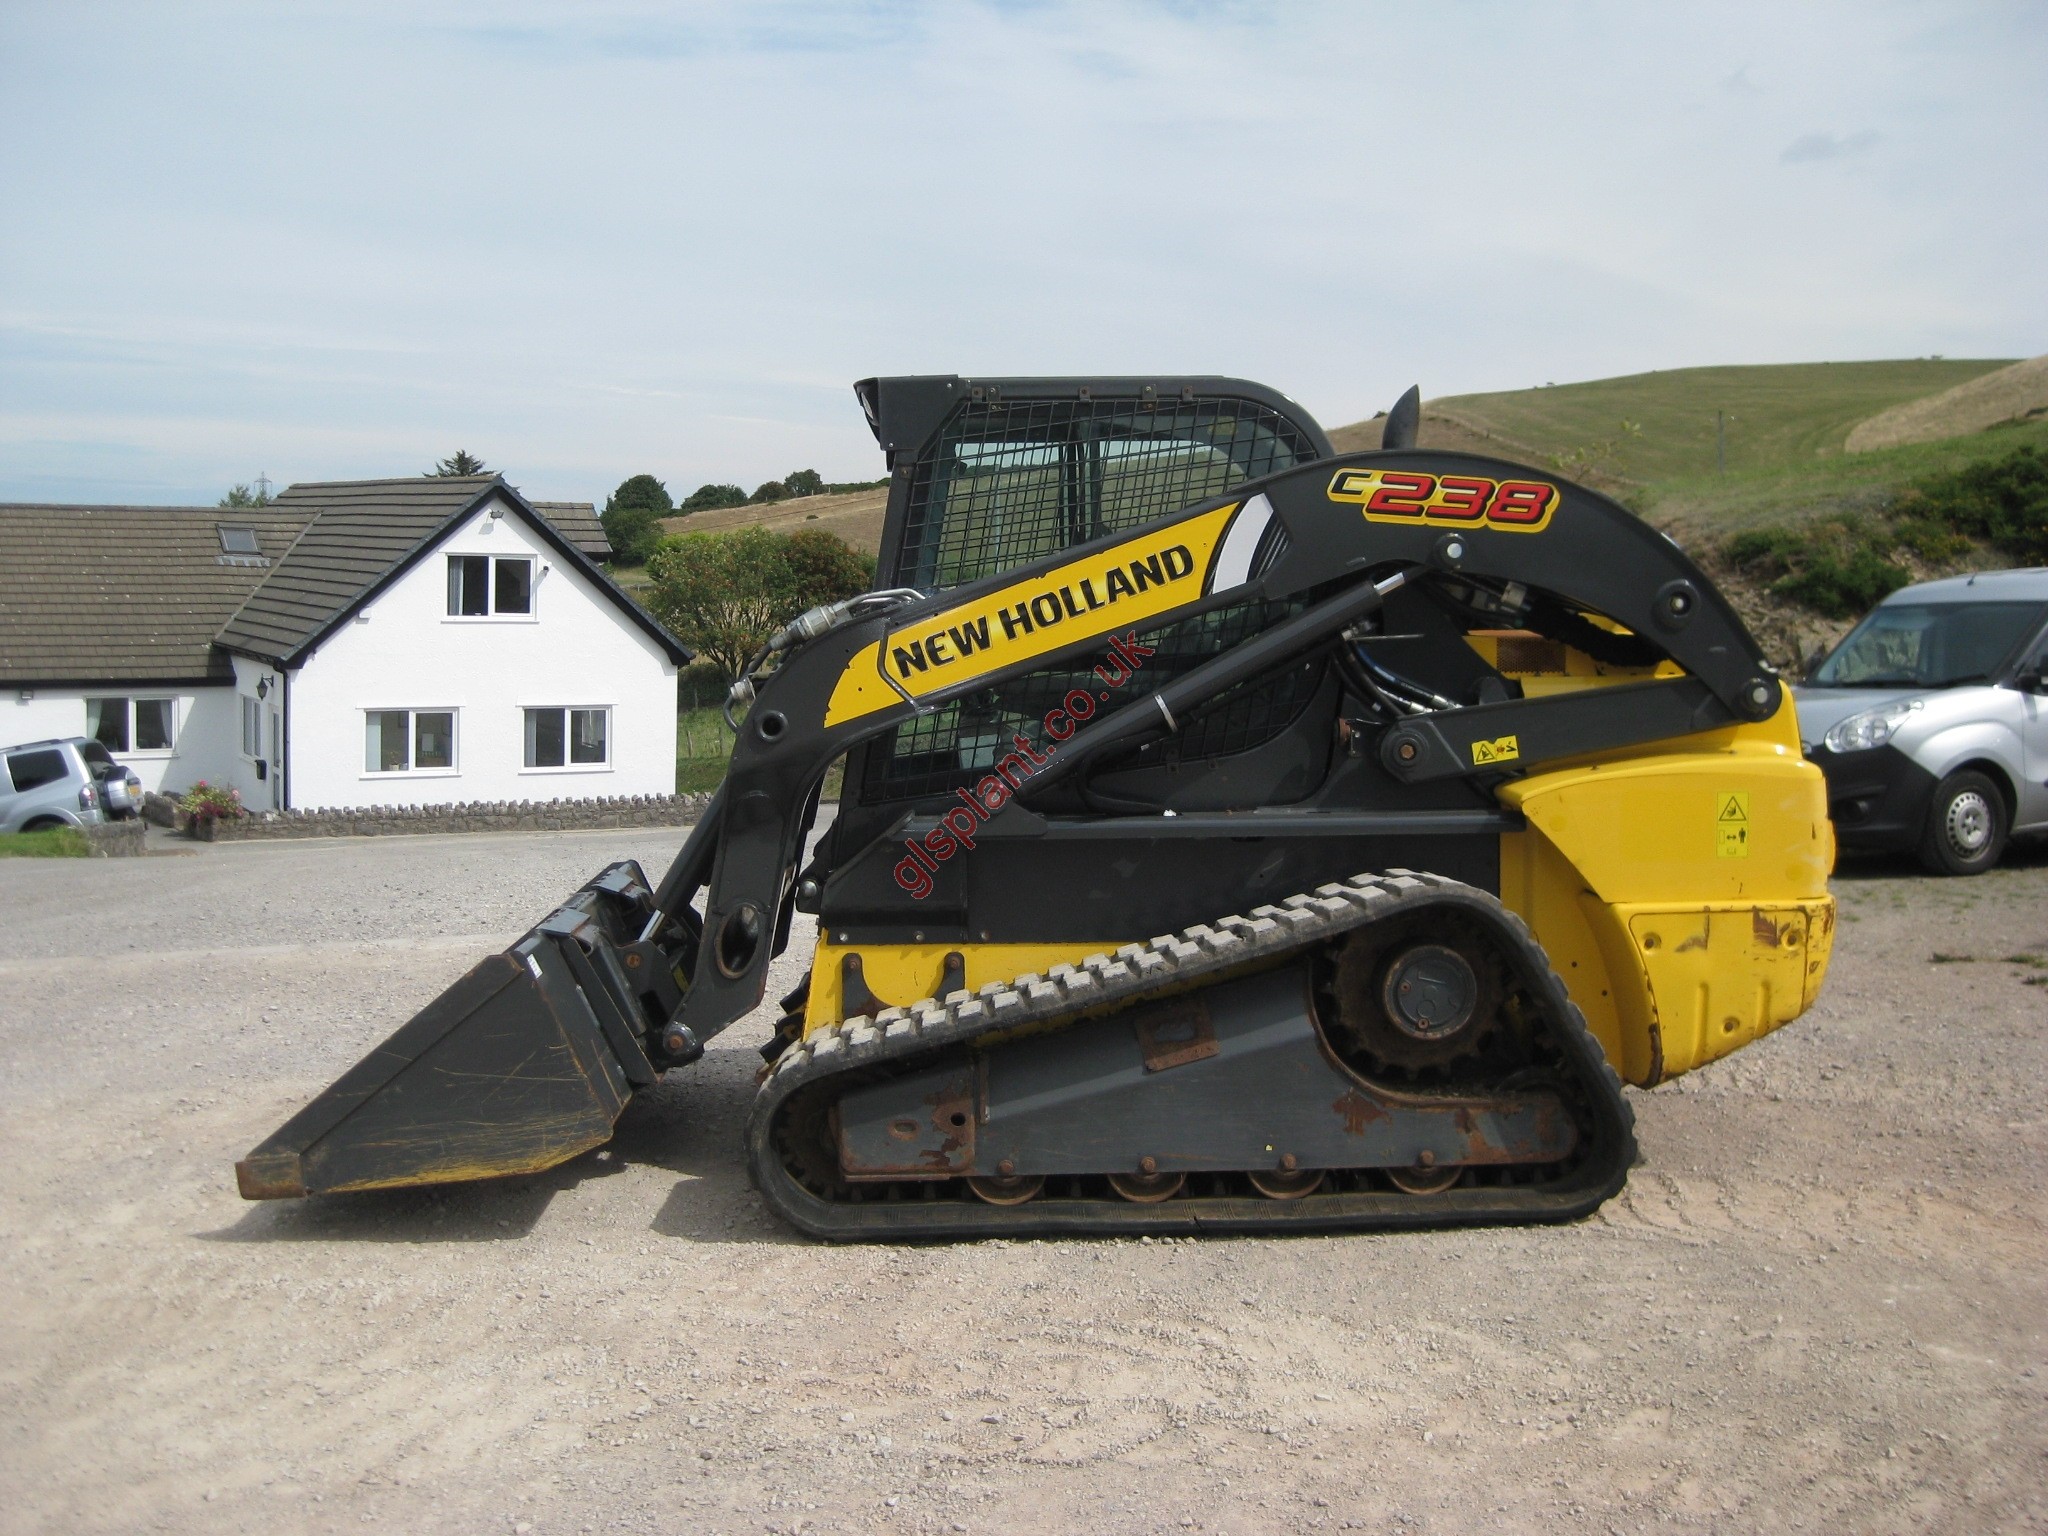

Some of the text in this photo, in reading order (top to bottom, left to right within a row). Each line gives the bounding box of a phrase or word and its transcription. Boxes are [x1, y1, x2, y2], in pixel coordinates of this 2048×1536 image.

[1330, 471, 1555, 525] C238
[891, 544, 1195, 680] NEW HOLLAND
